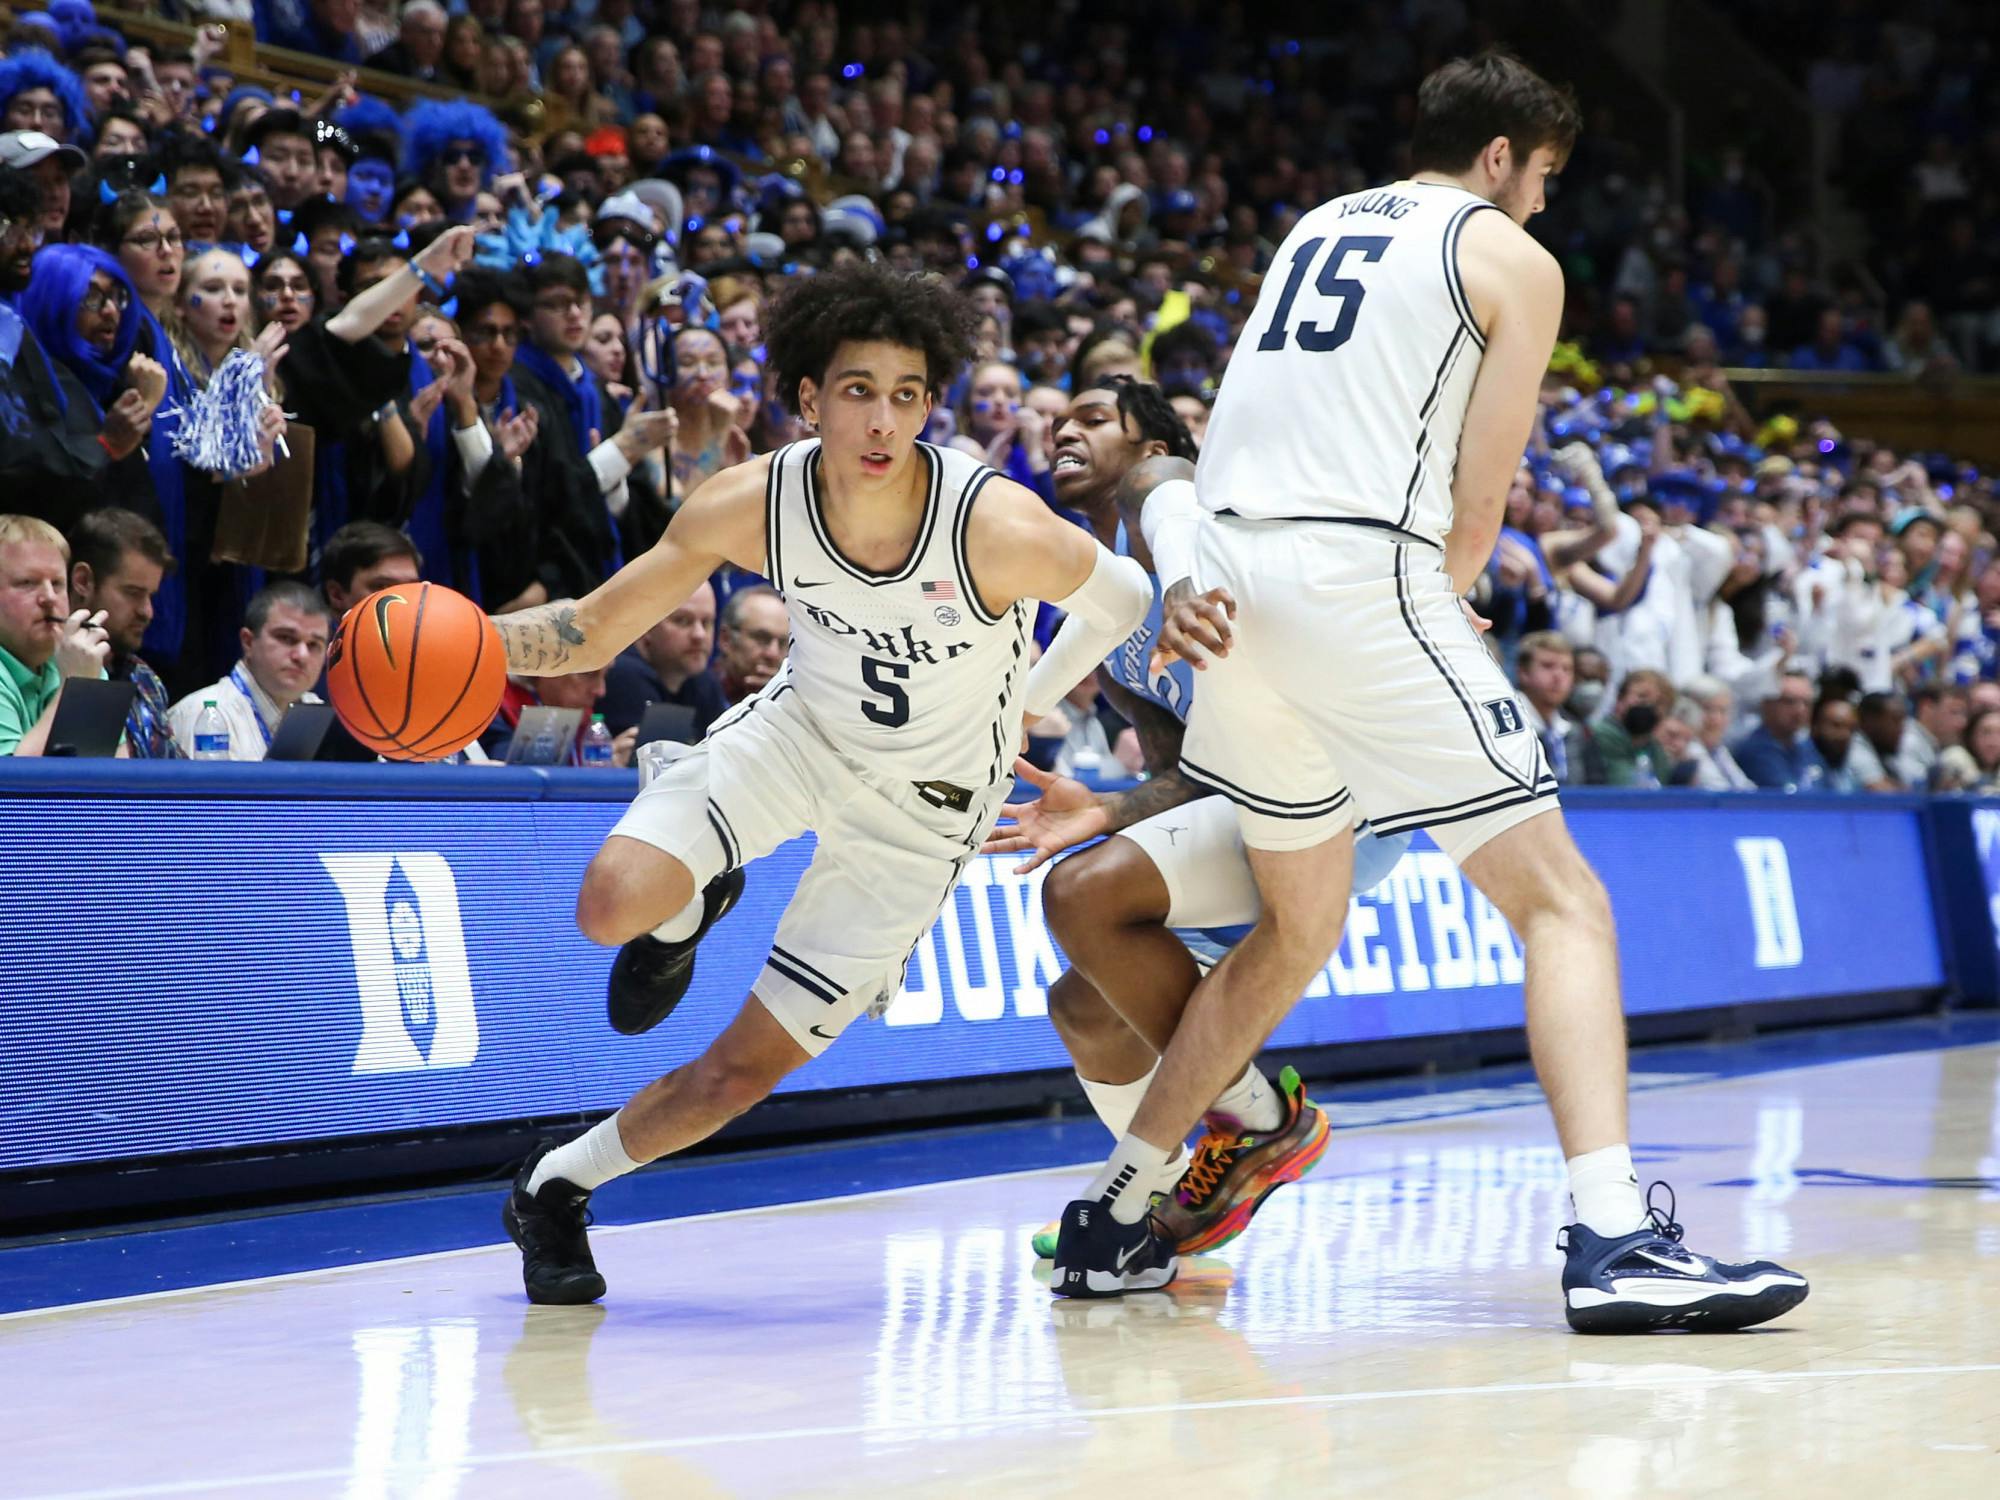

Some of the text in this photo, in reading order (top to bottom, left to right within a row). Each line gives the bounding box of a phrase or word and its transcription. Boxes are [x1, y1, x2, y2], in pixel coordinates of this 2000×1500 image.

[1337, 192, 1419, 220] YOUNG
[1257, 235, 1395, 352] 15
[861, 655, 910, 728] 5
